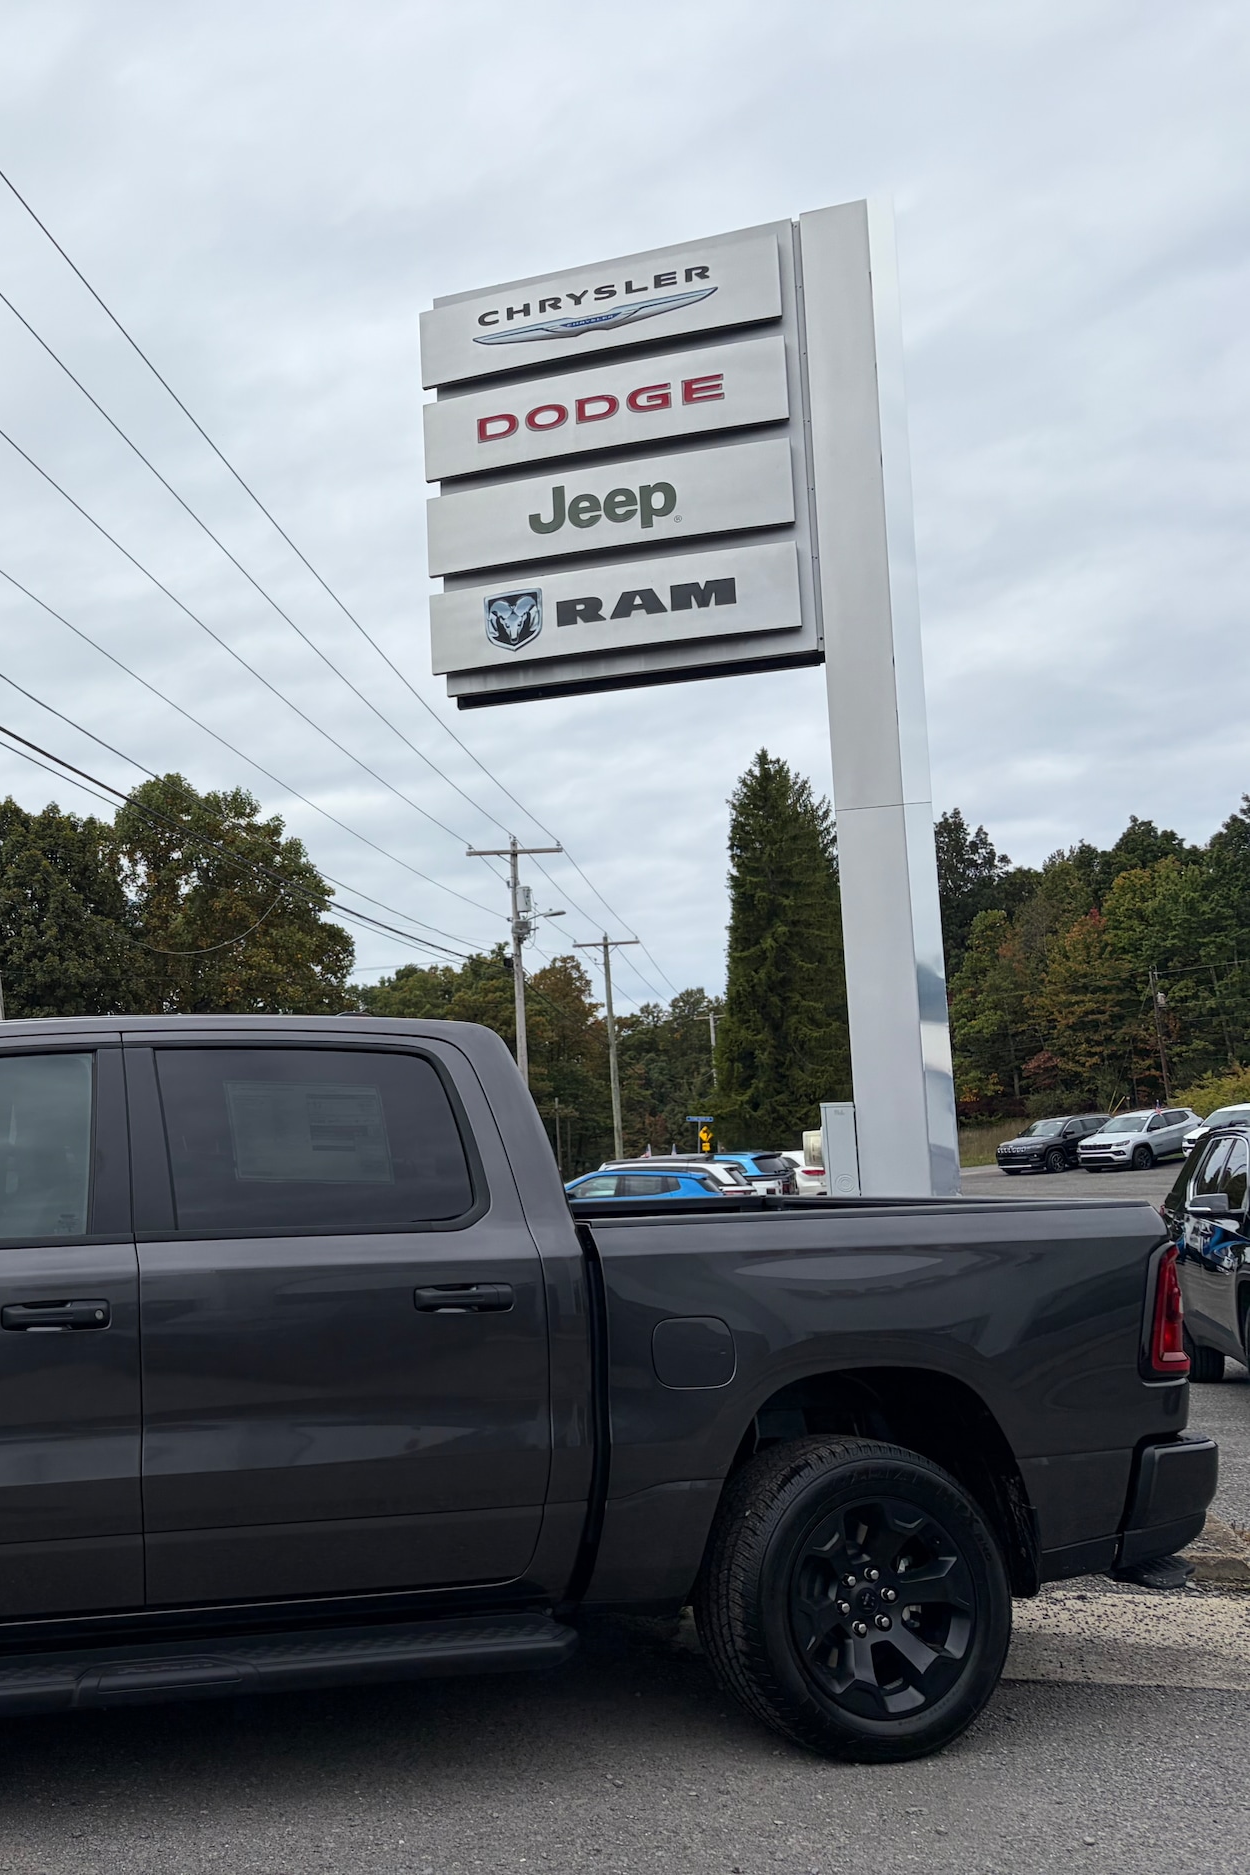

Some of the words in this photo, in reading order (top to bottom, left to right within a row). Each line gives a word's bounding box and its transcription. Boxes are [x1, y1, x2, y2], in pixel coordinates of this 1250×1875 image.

[477, 265, 711, 327] CHRYSLER
[477, 373, 725, 443] DODGE
[529, 481, 677, 535] Jeep
[556, 577, 737, 627] RAM
